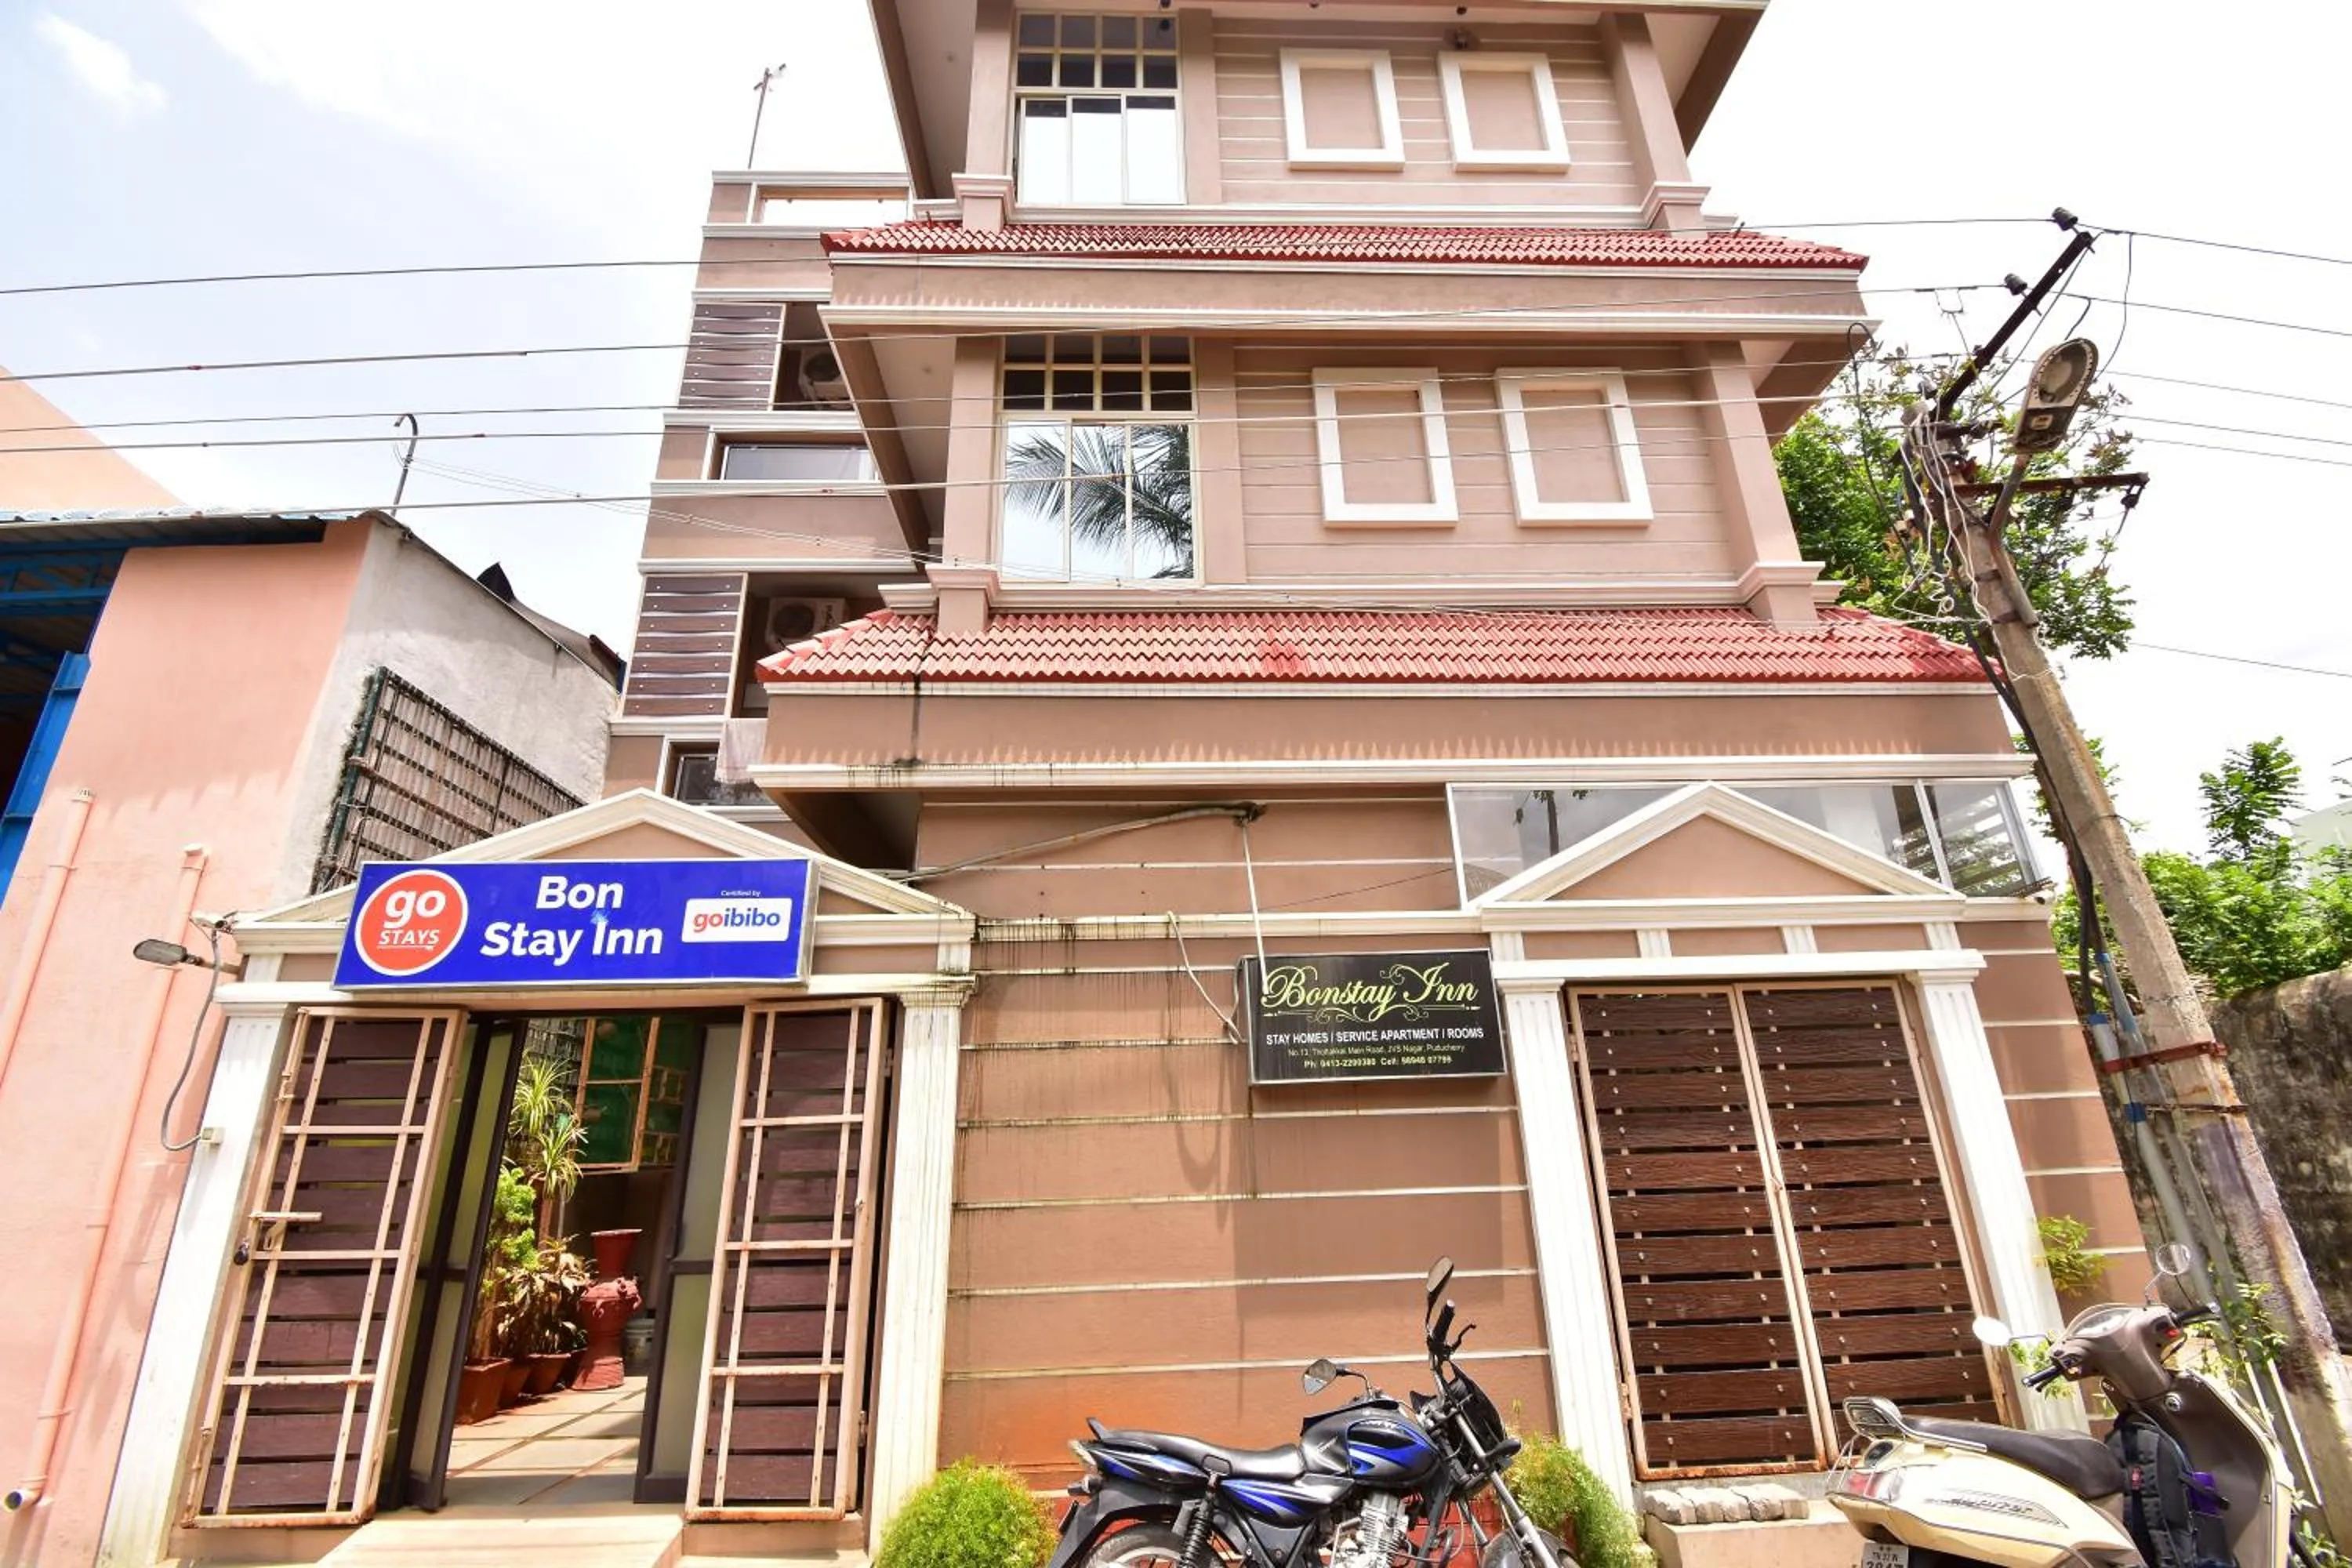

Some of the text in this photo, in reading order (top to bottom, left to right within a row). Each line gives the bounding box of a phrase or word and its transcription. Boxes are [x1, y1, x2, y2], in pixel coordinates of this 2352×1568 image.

[536, 876, 624, 909] Bon
[383, 890, 446, 929] go
[693, 907, 781, 935] goibibo
[377, 929, 441, 946] STAYS
[480, 919, 663, 967] Stay Inn
[1261, 962, 1480, 1022] Bonstay Inn
[1266, 1033, 1291, 1045] STAY
[1293, 1032, 1329, 1044] HOMES
[1336, 1030, 1379, 1042] SERVICE
[1381, 1028, 1440, 1040] APARTMENT
[1447, 1026, 1484, 1039] ROOMS
